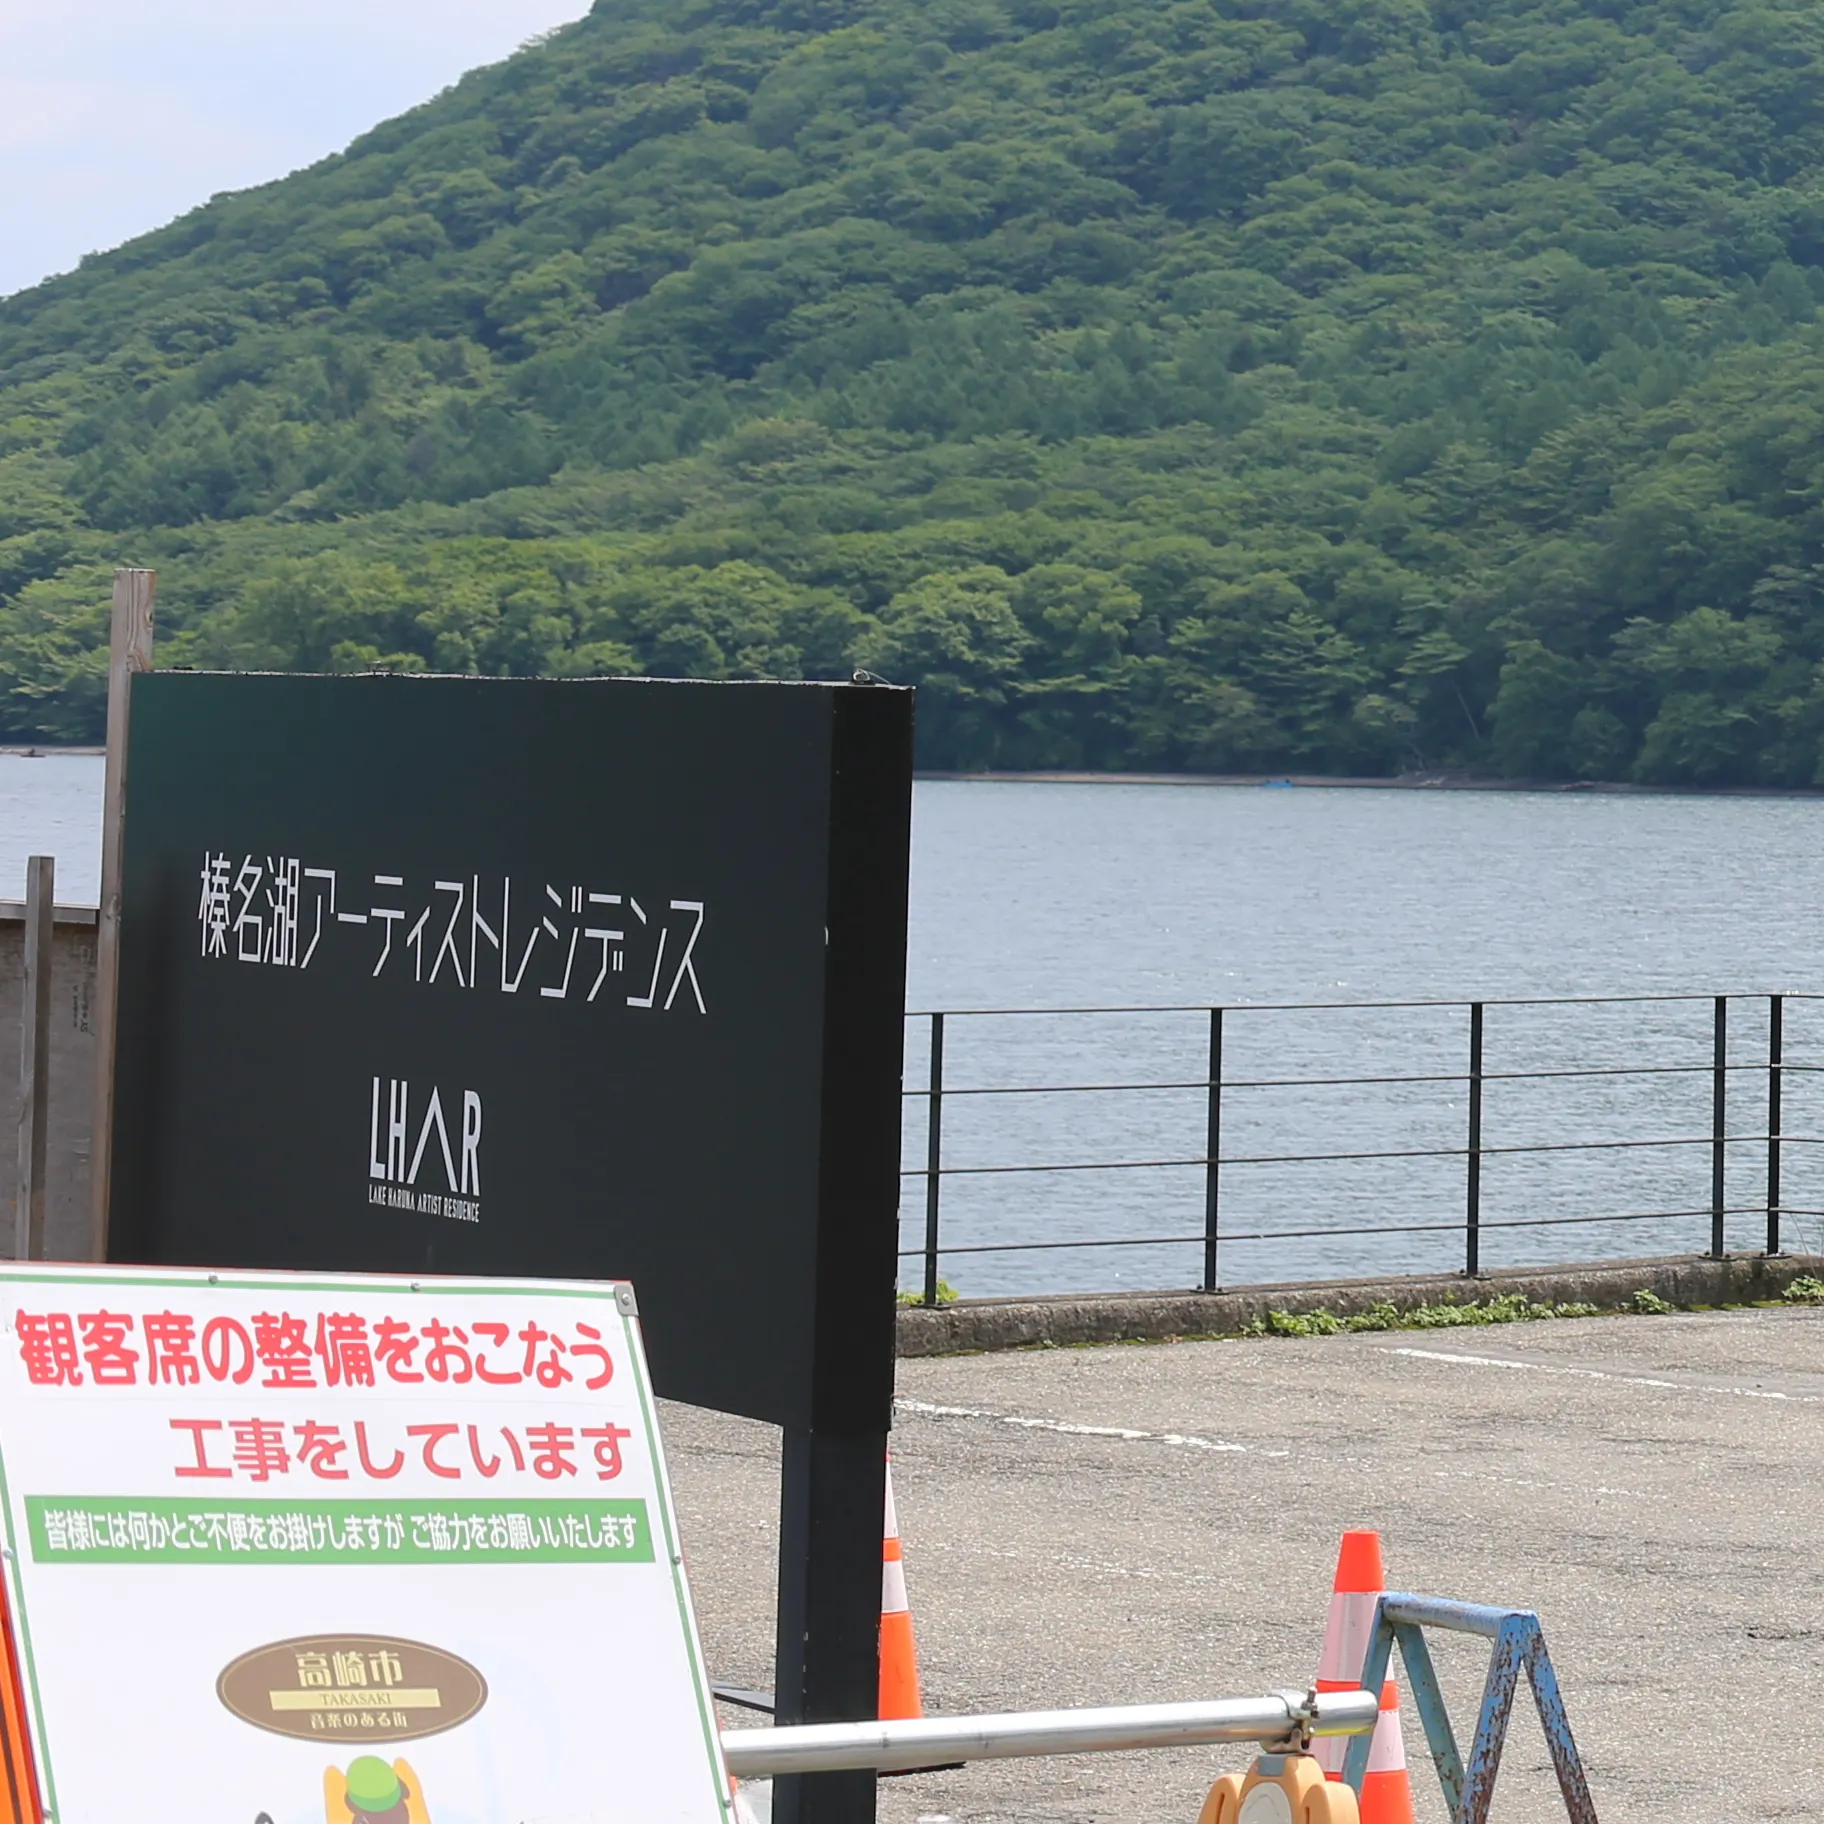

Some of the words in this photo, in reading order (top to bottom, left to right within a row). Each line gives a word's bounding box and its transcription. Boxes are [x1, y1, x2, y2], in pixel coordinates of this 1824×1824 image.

[198, 850, 707, 1014] 榛名湖アーティストレジデンス
[370, 1076, 482, 1197] LHAR
[369, 1184, 387, 1206] LAKE
[388, 1187, 415, 1210] HARUNA
[417, 1193, 442, 1216] ARTIST
[443, 1197, 480, 1223] RESIDENCE
[15, 1309, 614, 1391] 観客席の整備をおこなう
[168, 1416, 632, 1482] 工事をしています
[44, 1509, 405, 1551] 皆様には何かとご不便をお掛けしますが
[410, 1512, 637, 1551] ご協力をお願いいたします
[295, 1650, 403, 1687] 高崎市
[319, 1692, 393, 1706] TAKASAKI
